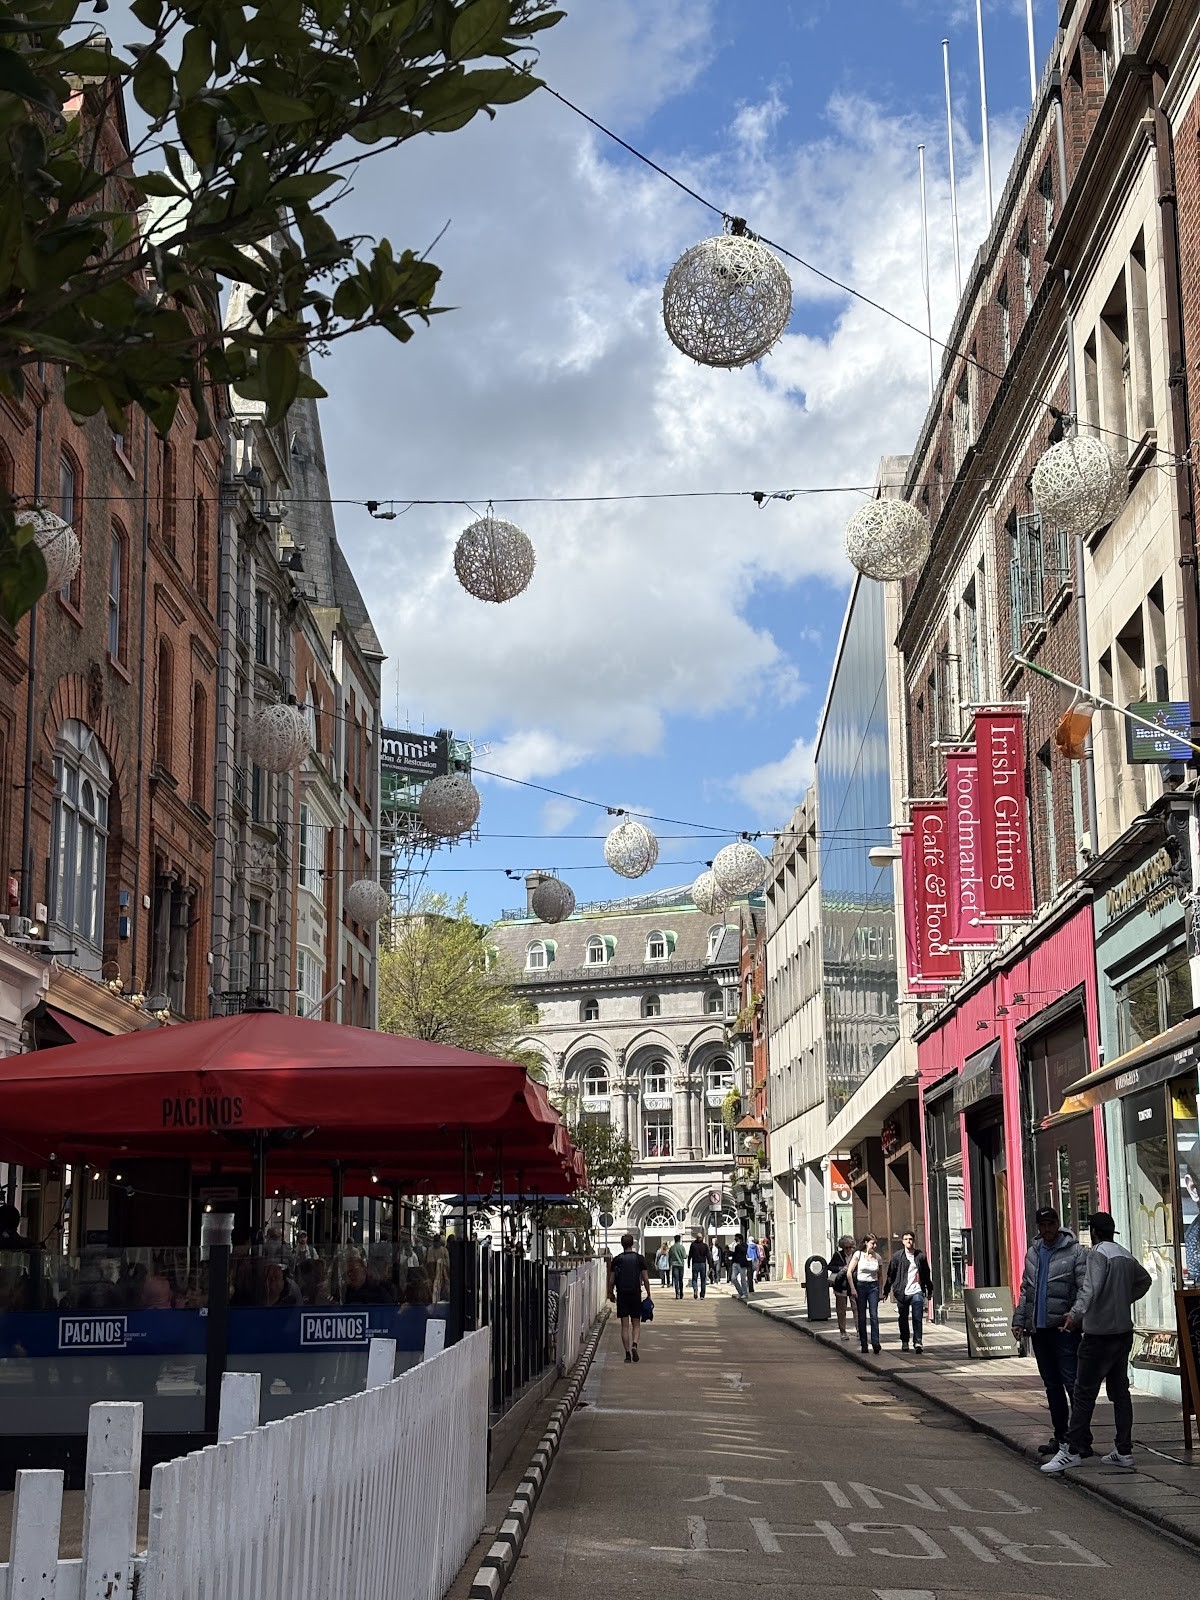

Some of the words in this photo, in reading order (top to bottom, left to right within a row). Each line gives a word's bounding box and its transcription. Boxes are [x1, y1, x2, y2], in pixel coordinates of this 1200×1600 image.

[380, 738, 438, 758] mmit
[396, 756, 403, 764] &
[404, 757, 437, 768] Restoration
[991, 724, 1016, 786] Irish
[921, 814, 945, 868] Café
[956, 765, 984, 914] Foodmarket
[990, 795, 1022, 891] Gifting
[924, 873, 946, 896] &
[925, 902, 951, 957] Food
[162, 1096, 243, 1127] PACINOS
[64, 1321, 121, 1343] PACINOS
[307, 1318, 362, 1339] PACINOS
[683, 1475, 1041, 1515] ONLY
[650, 1514, 1113, 1568] RIGHT
